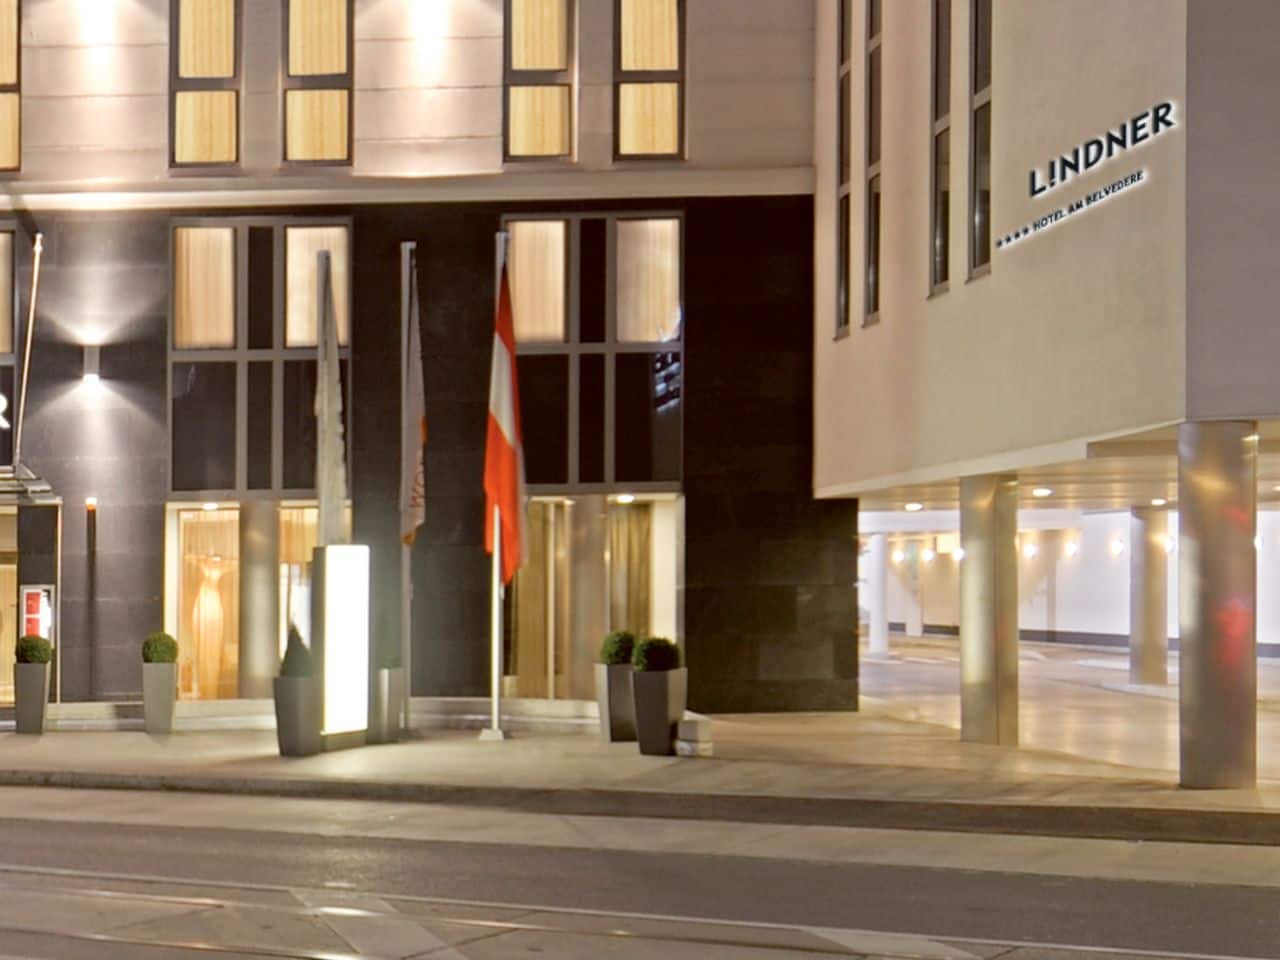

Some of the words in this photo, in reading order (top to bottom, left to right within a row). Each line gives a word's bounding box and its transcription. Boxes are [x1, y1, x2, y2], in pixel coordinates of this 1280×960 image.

[1032, 209, 1066, 232] HOTEL
[1067, 199, 1084, 215] AM
[1085, 169, 1144, 207] BELVEDERE
